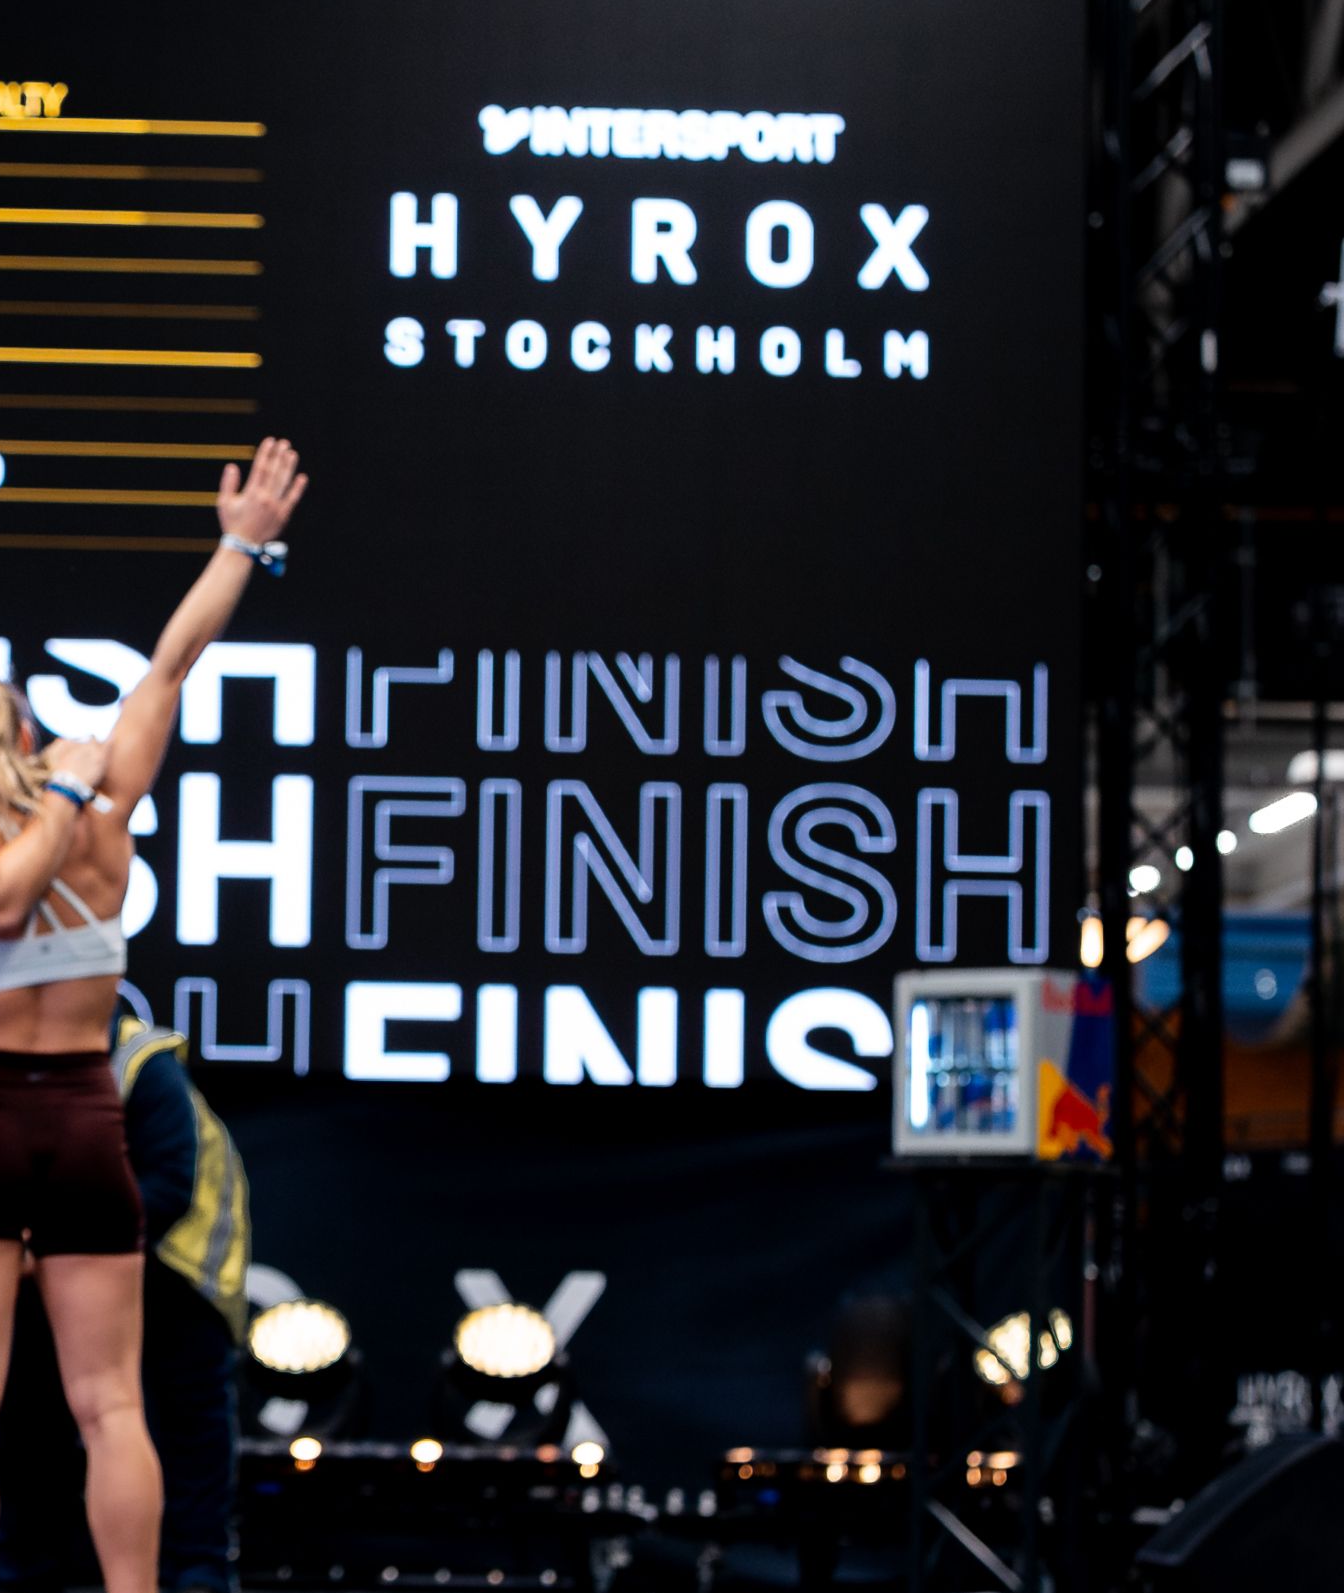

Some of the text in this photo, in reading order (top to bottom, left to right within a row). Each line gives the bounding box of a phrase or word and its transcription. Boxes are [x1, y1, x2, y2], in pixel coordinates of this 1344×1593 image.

[389, 191, 929, 292] HYROX
[383, 316, 929, 380] STOCKHOLM
[345, 774, 1050, 964] FINISH
